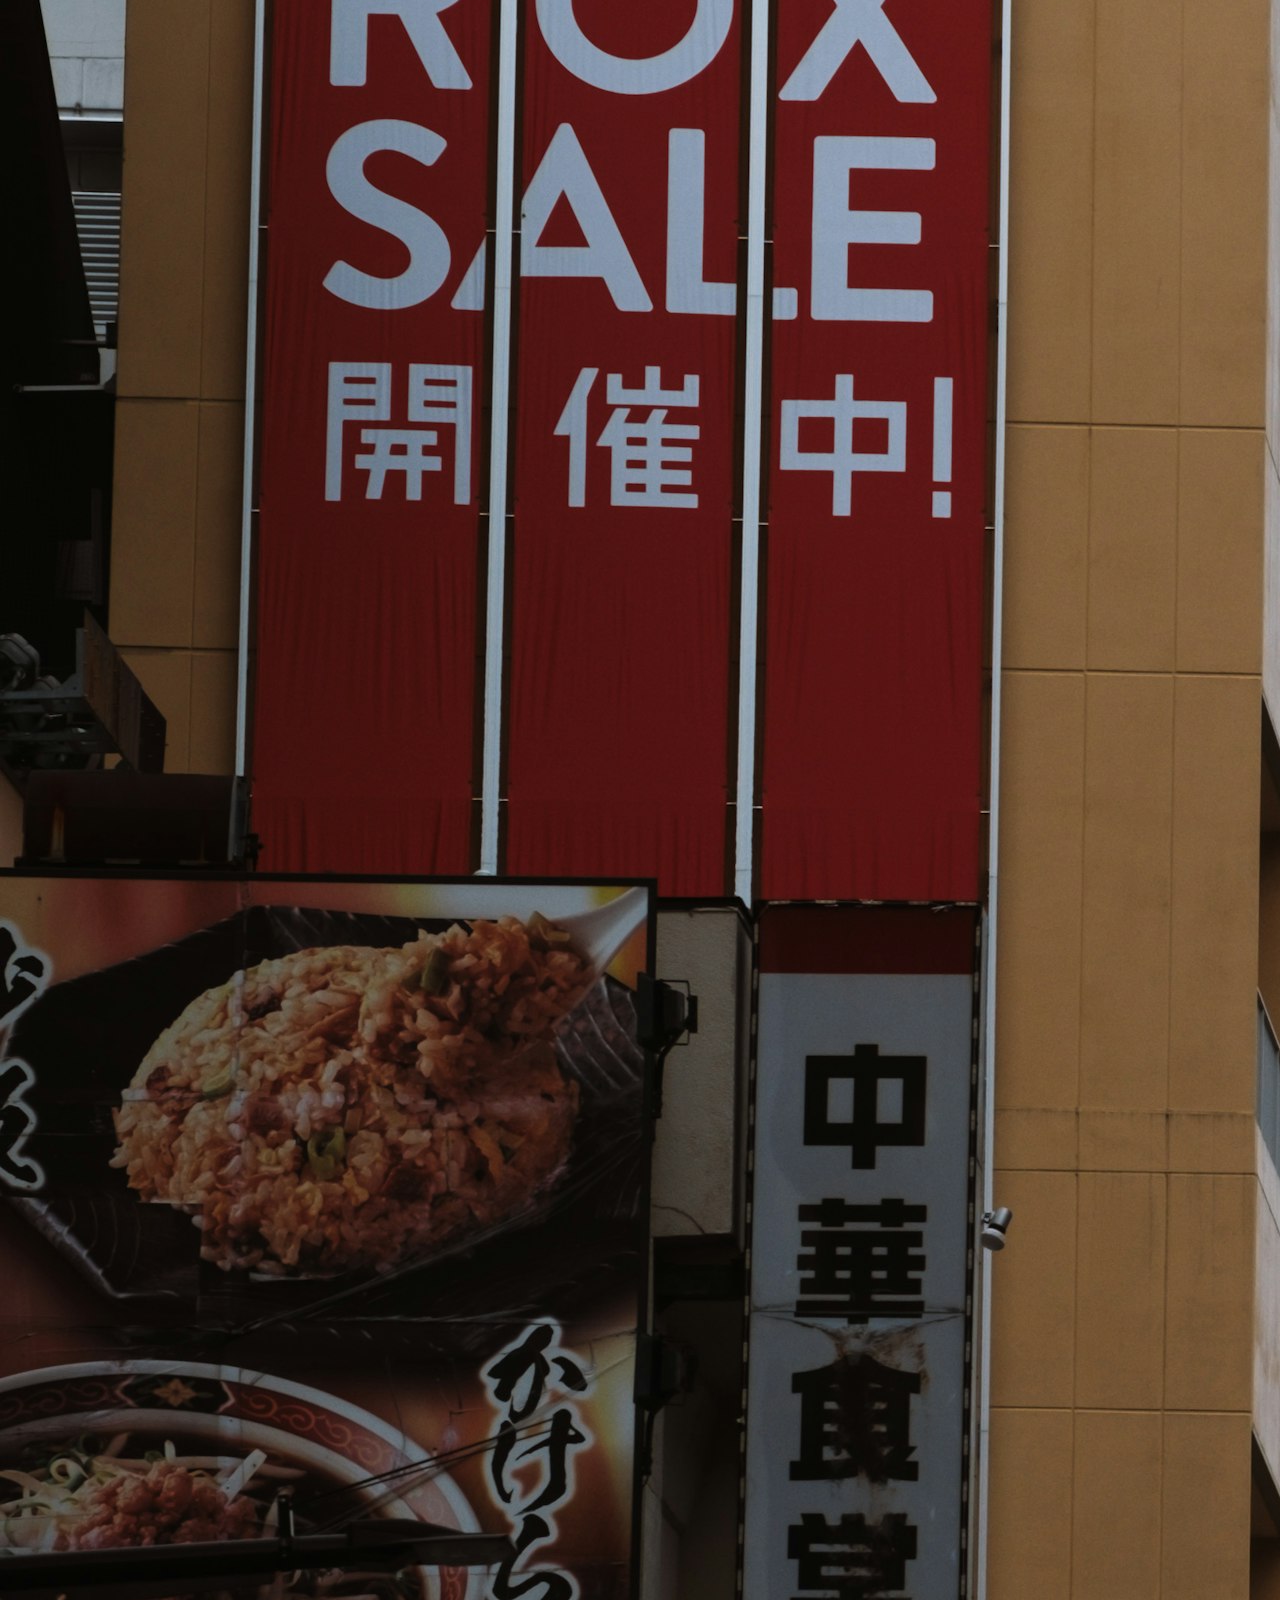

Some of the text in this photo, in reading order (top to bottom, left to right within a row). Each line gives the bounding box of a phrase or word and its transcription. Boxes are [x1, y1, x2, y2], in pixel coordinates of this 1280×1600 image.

[322, 118, 937, 323] SALE
[324, 361, 953, 518] 開催中!
